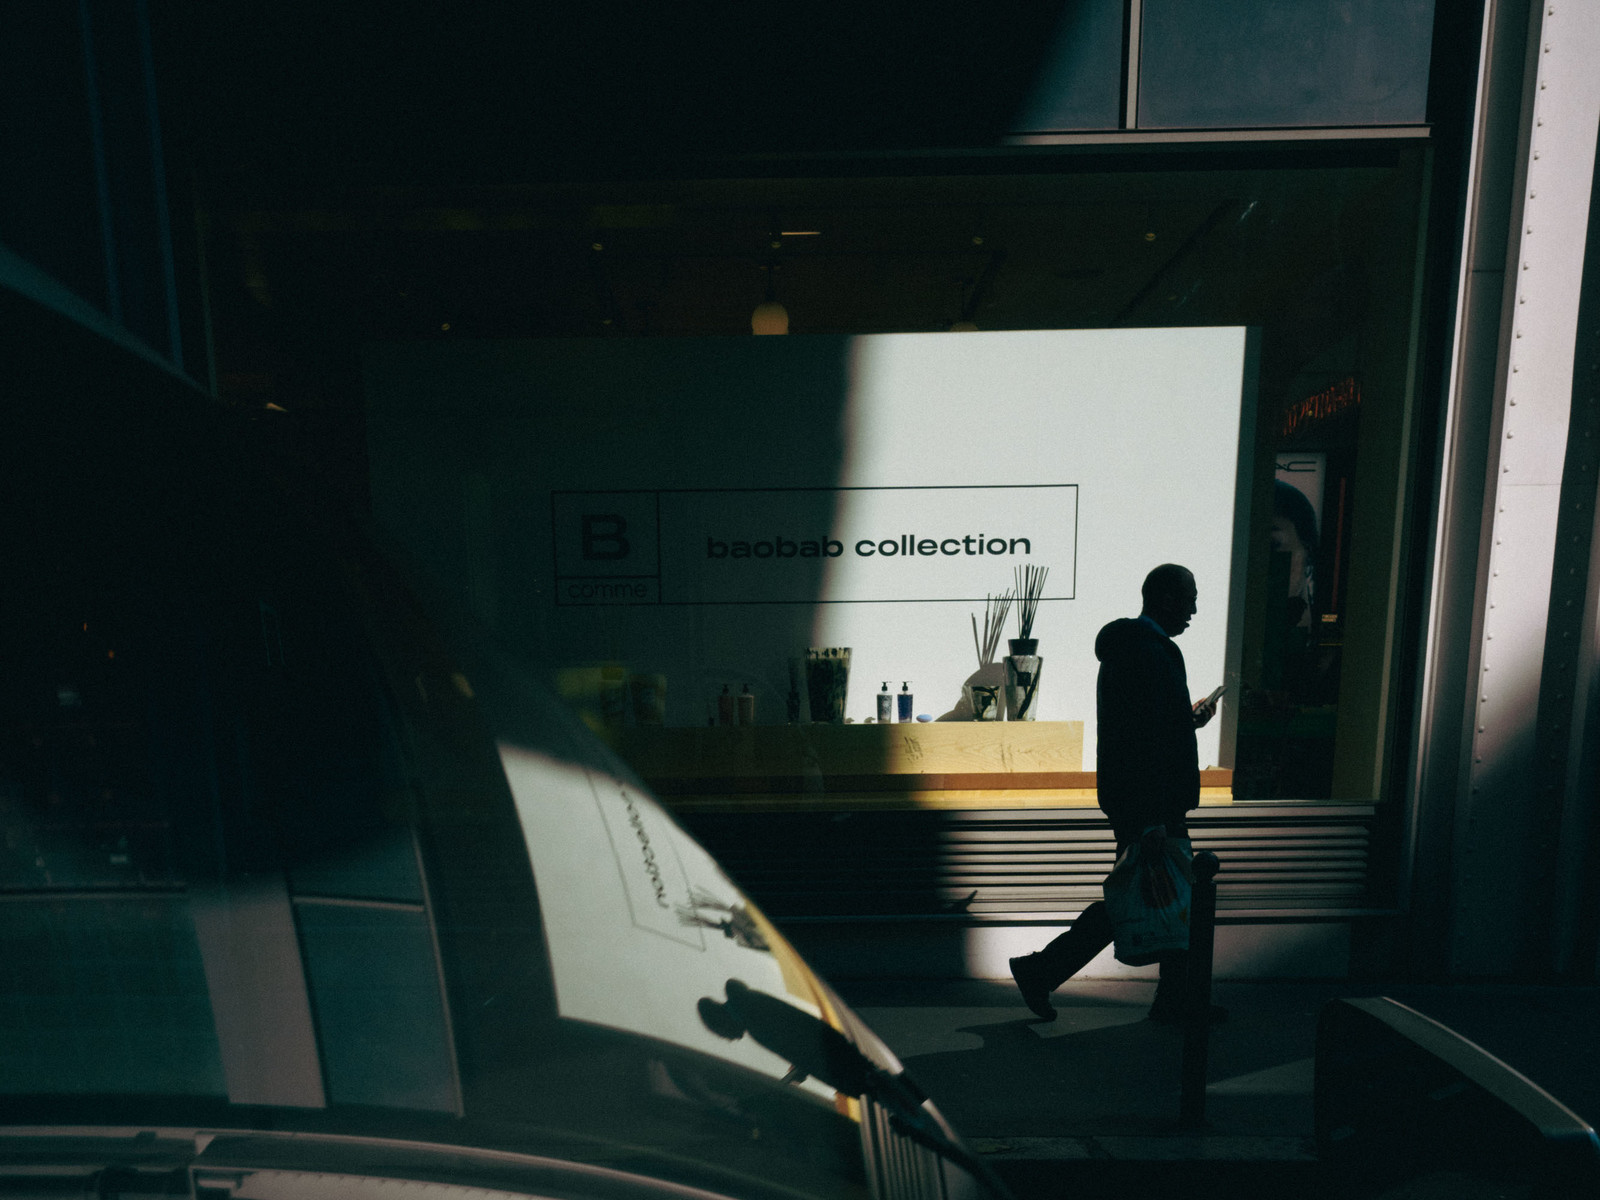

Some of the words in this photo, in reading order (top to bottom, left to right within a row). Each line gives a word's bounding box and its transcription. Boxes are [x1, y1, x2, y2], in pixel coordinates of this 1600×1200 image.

[581, 514, 630, 561] B
[706, 534, 844, 559] baobab
[854, 533, 1032, 558] collection
[567, 582, 648, 599] comme
